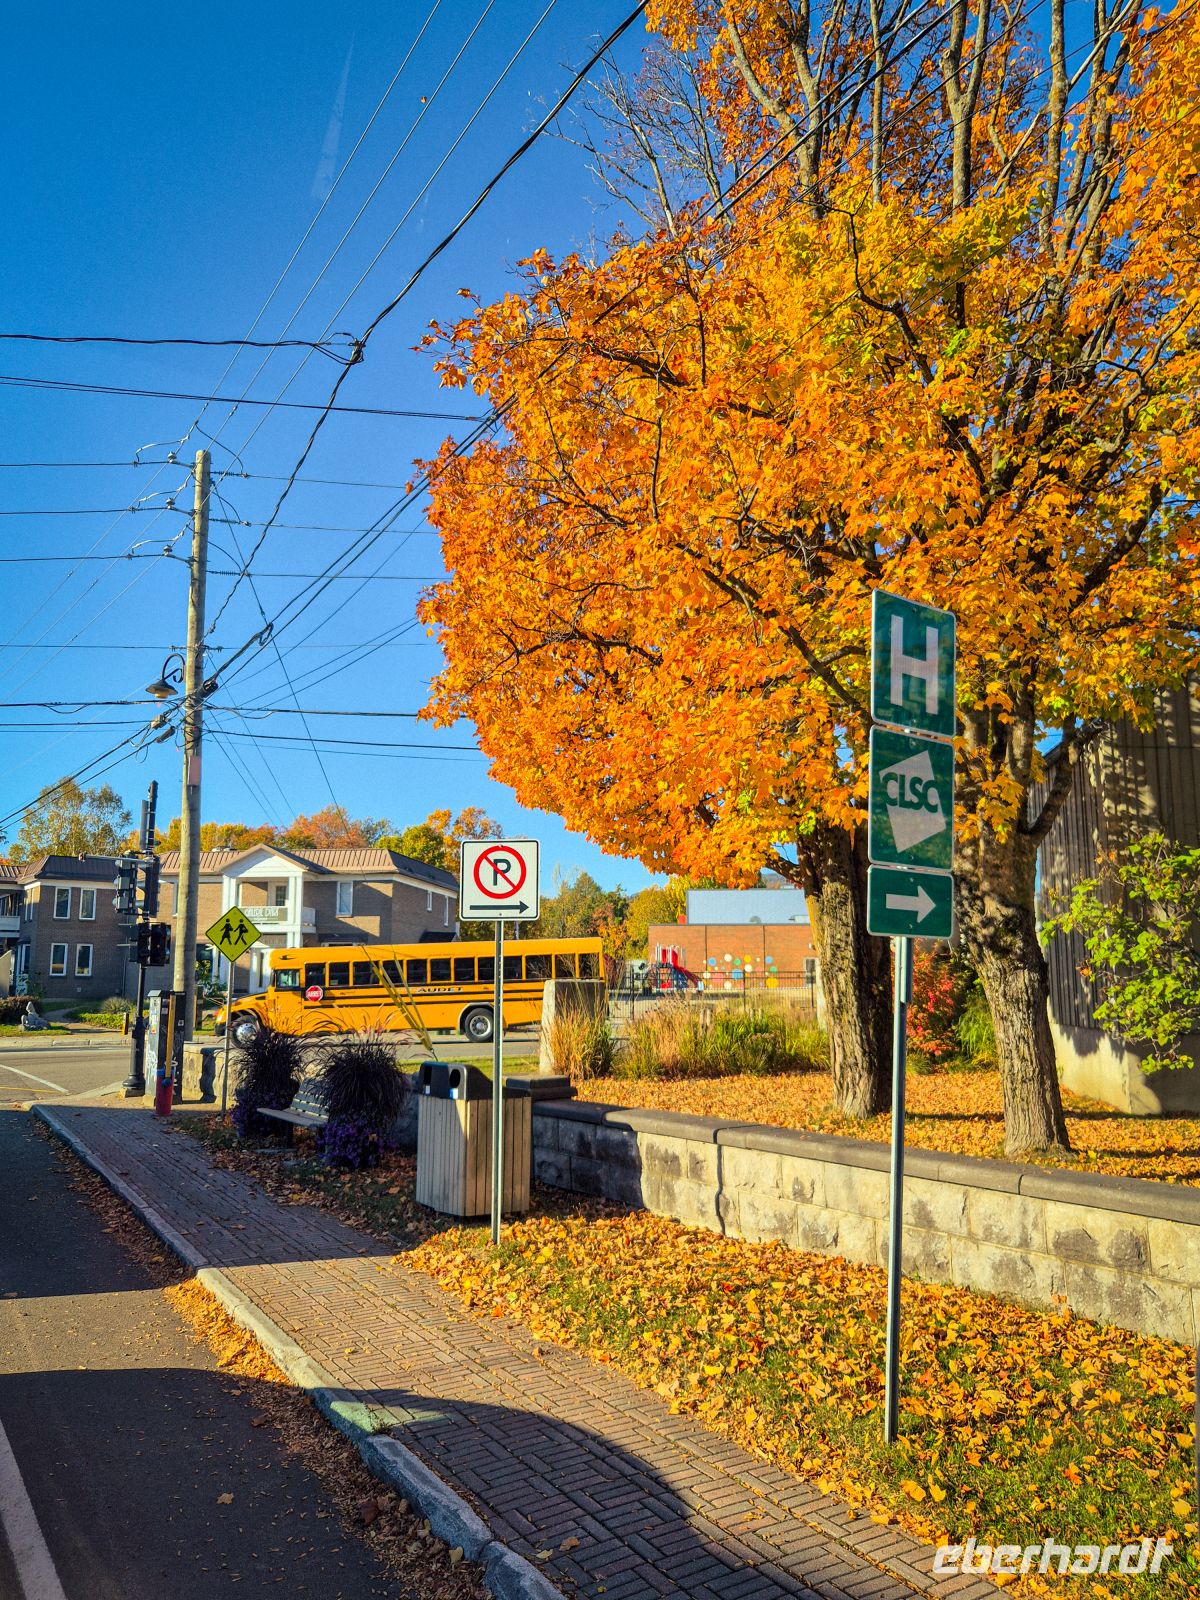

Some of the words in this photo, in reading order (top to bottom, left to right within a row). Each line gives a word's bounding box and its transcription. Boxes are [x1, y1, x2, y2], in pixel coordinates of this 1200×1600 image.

[890, 614, 939, 715] H
[881, 772, 939, 813] CLSC
[493, 858, 511, 886] P
[418, 986, 463, 994] AUDET
